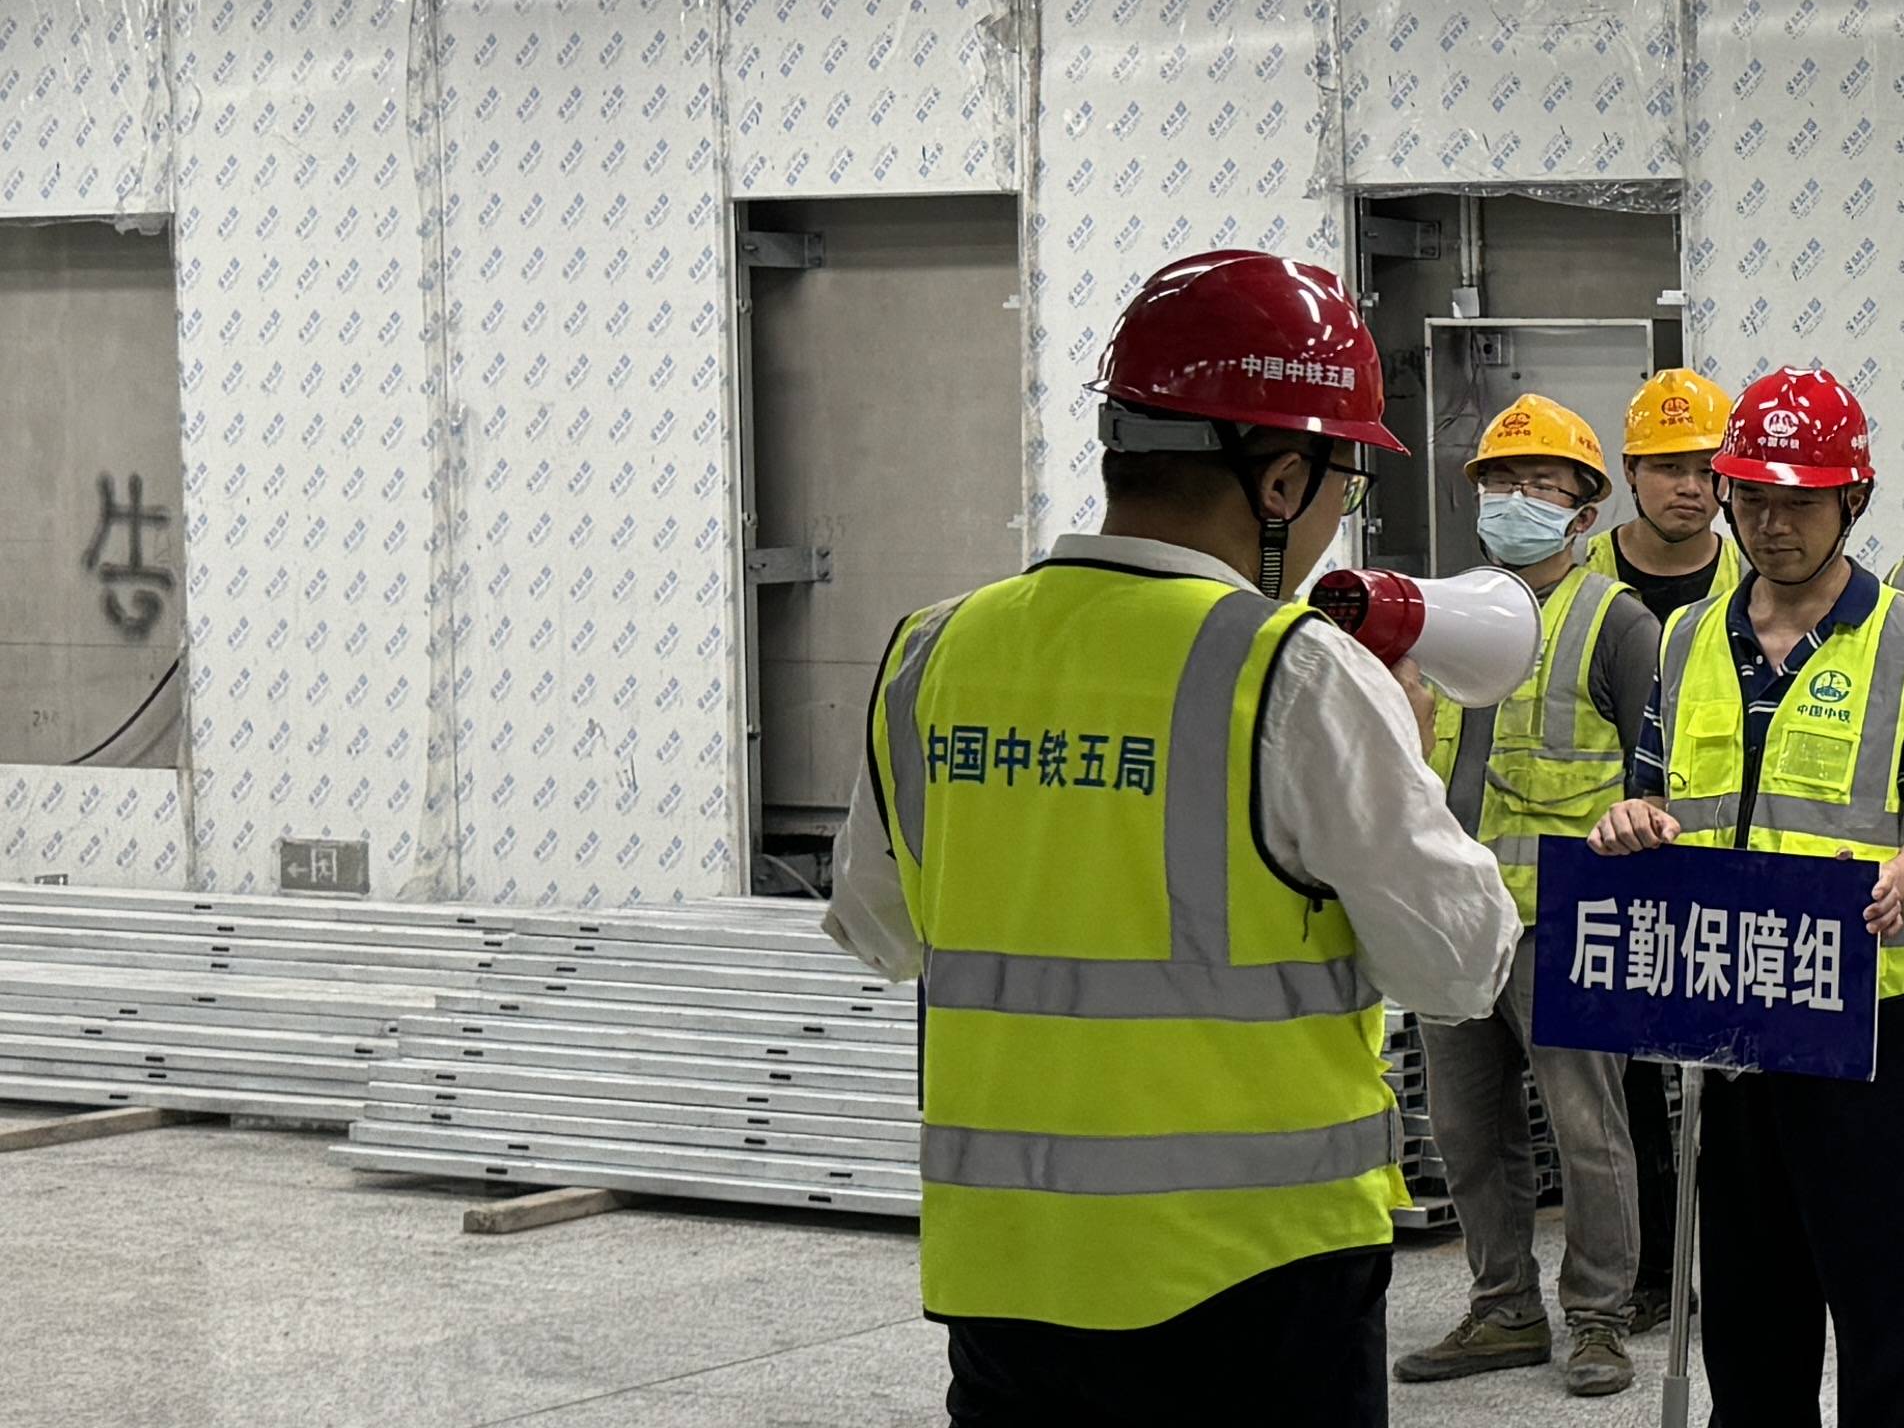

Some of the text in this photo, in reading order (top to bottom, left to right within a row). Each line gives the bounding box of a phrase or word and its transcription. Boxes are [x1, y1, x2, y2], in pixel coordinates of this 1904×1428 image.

[1240, 353, 1356, 392] 中国中铁五局
[1797, 704, 1851, 723] 中国中铁
[927, 724, 1156, 798] 中国中铁五局
[1569, 897, 1844, 1012] 后勤保障组
